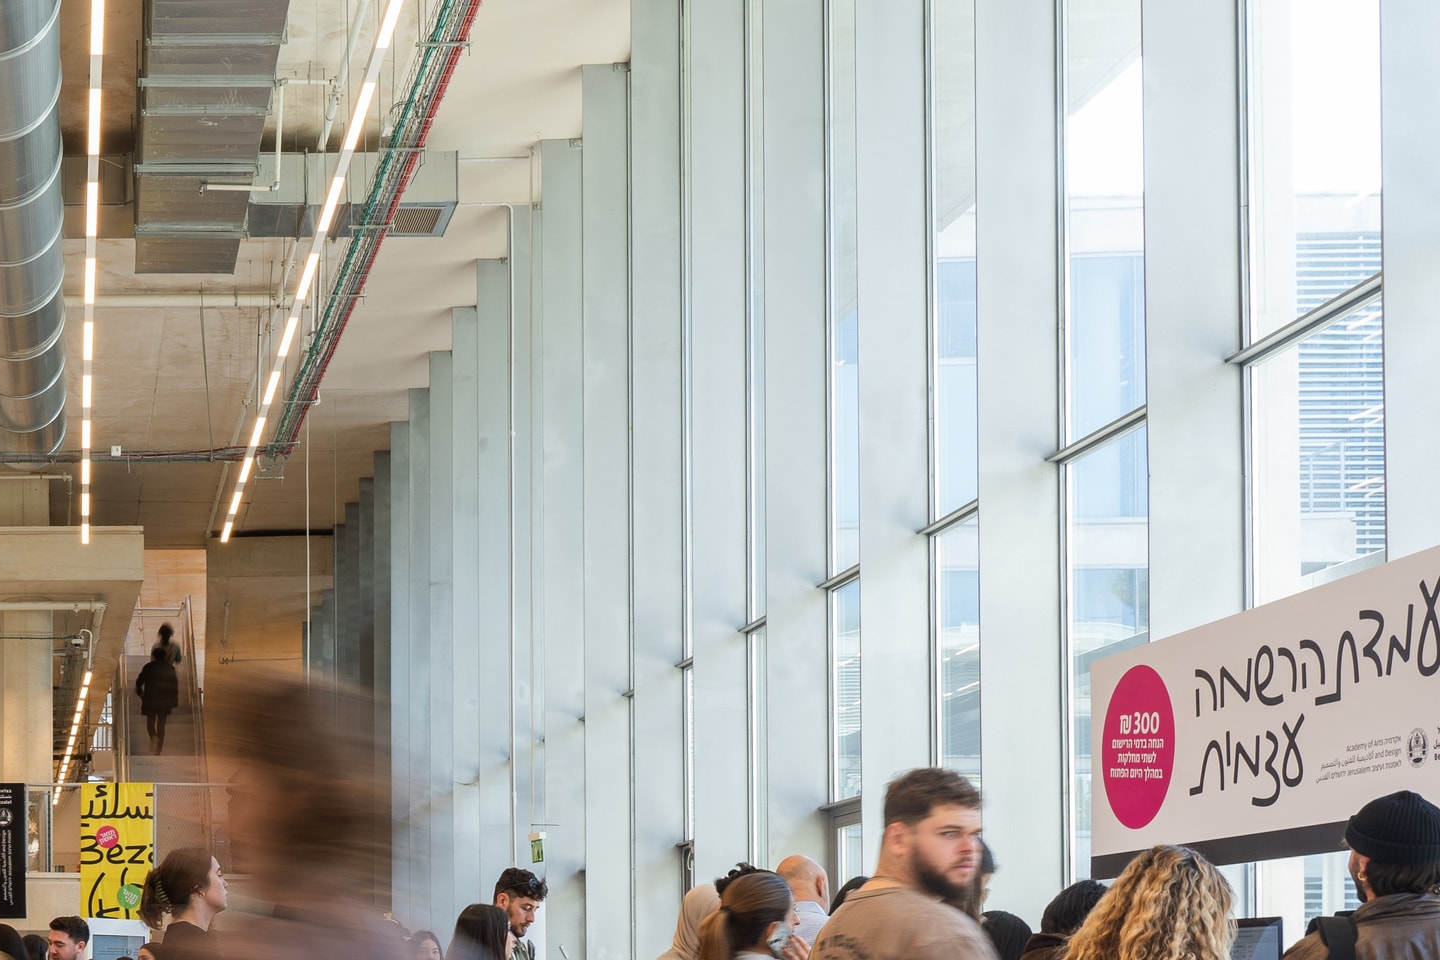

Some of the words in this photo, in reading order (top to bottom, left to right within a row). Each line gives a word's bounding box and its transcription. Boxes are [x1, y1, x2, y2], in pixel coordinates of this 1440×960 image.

[1194, 639, 1326, 717] הרשמה
[1315, 574, 1440, 706] עמדת
[1189, 713, 1305, 807] עצמית
